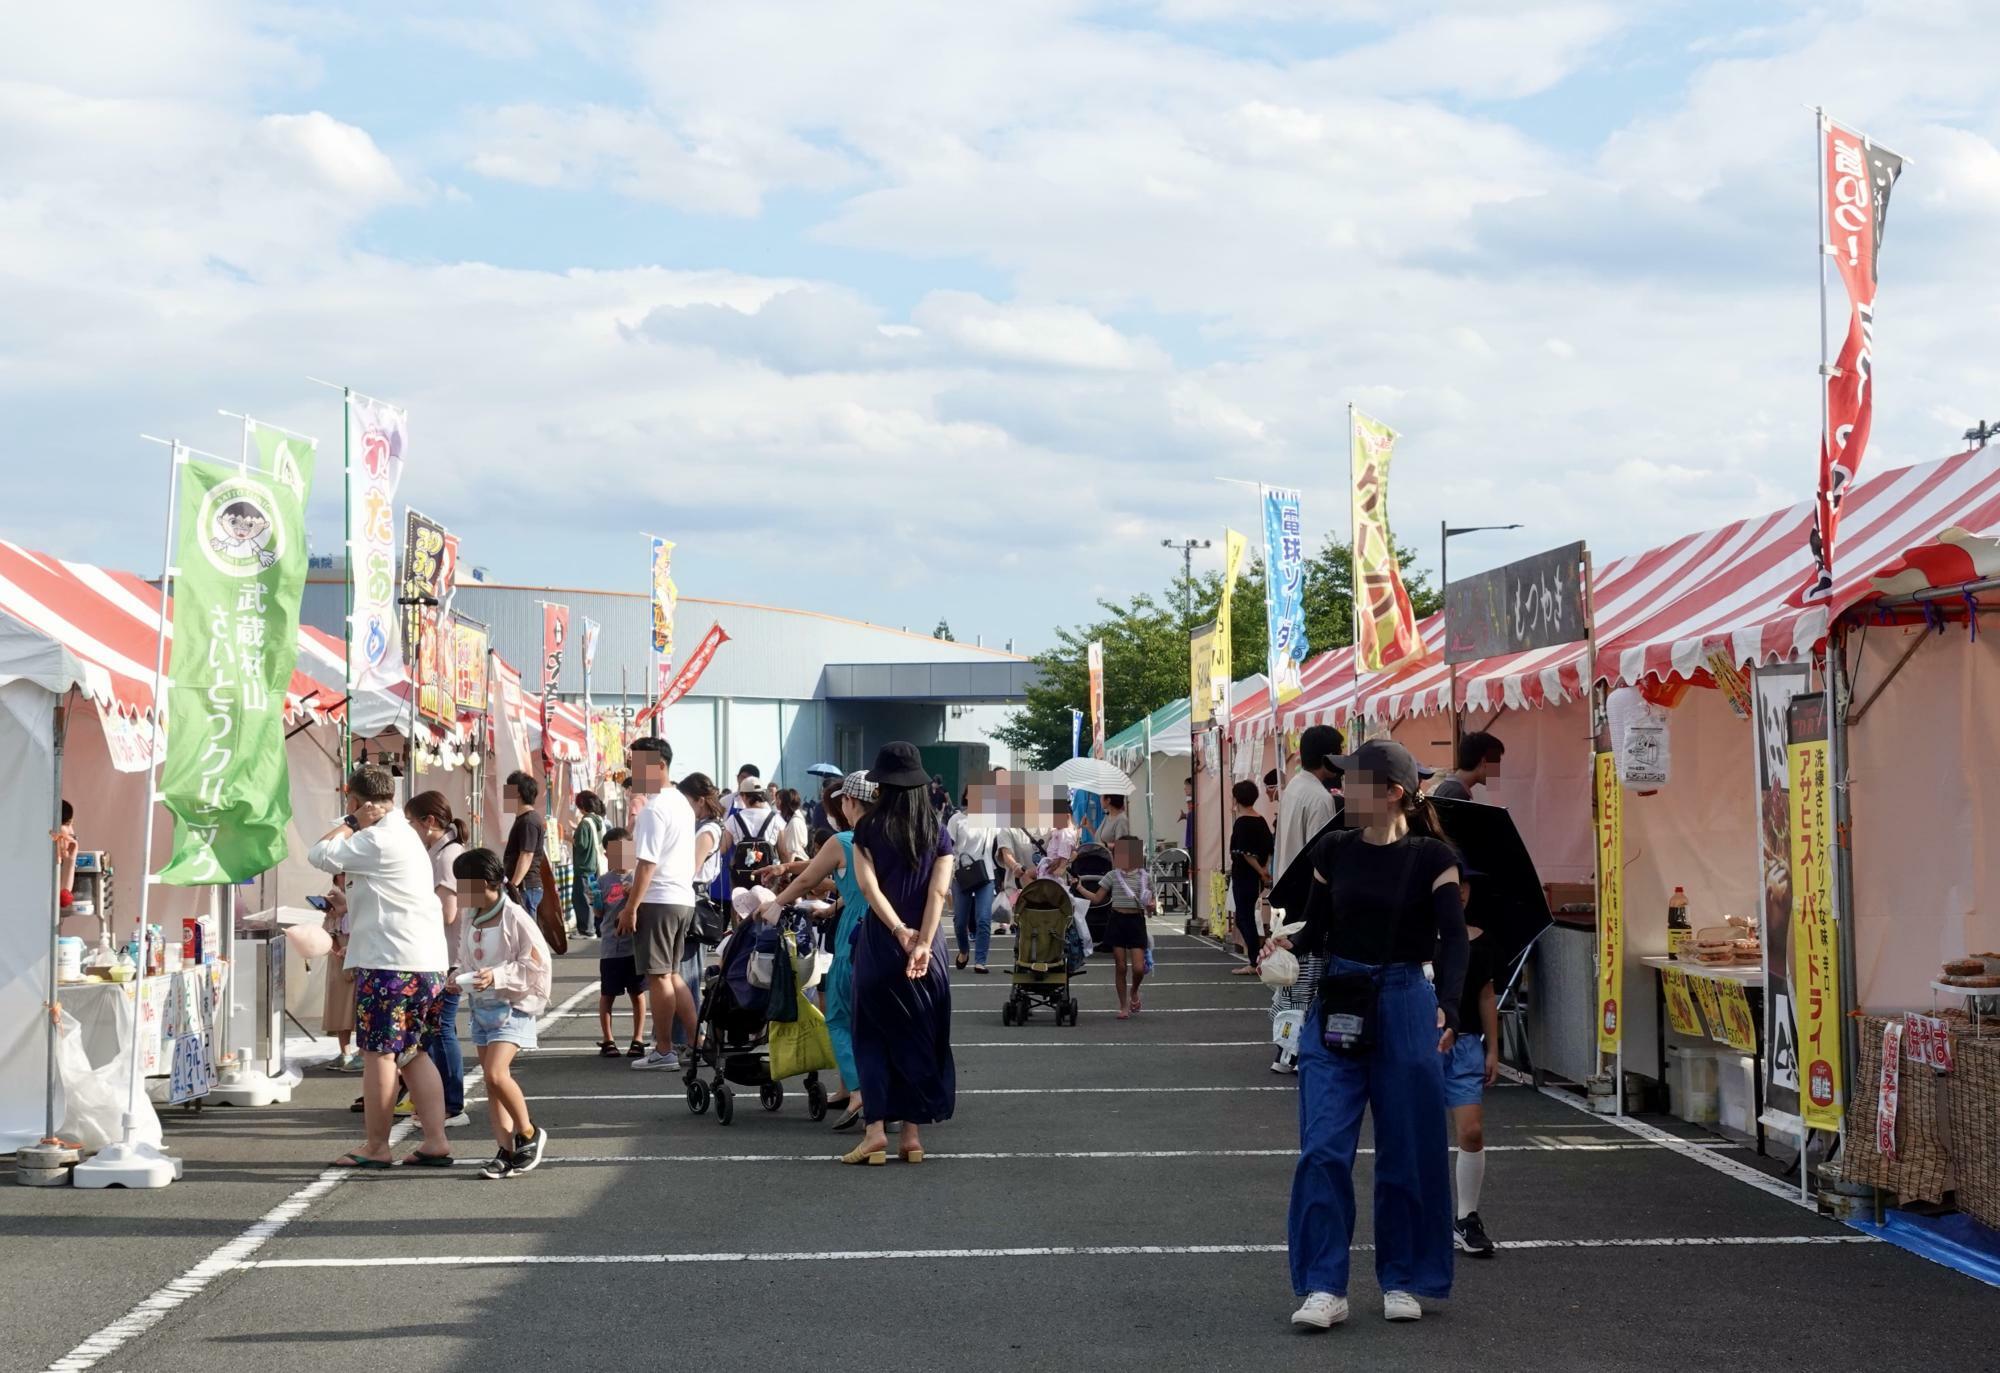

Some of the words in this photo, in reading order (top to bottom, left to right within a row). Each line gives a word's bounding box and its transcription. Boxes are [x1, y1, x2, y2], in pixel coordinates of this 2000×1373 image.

[362, 430, 392, 667] わたあめ
[1278, 507, 1300, 648] 電球ソーダ
[1515, 564, 1563, 641] もつやき
[236, 582, 267, 711] 武蔵村山
[187, 604, 235, 882] さいとうクリニック
[1602, 758, 1615, 996] アサヒスーパードライ
[1799, 749, 1823, 1056] アサヒスーパードライ
[1907, 1016, 1953, 1070] 焼そば
